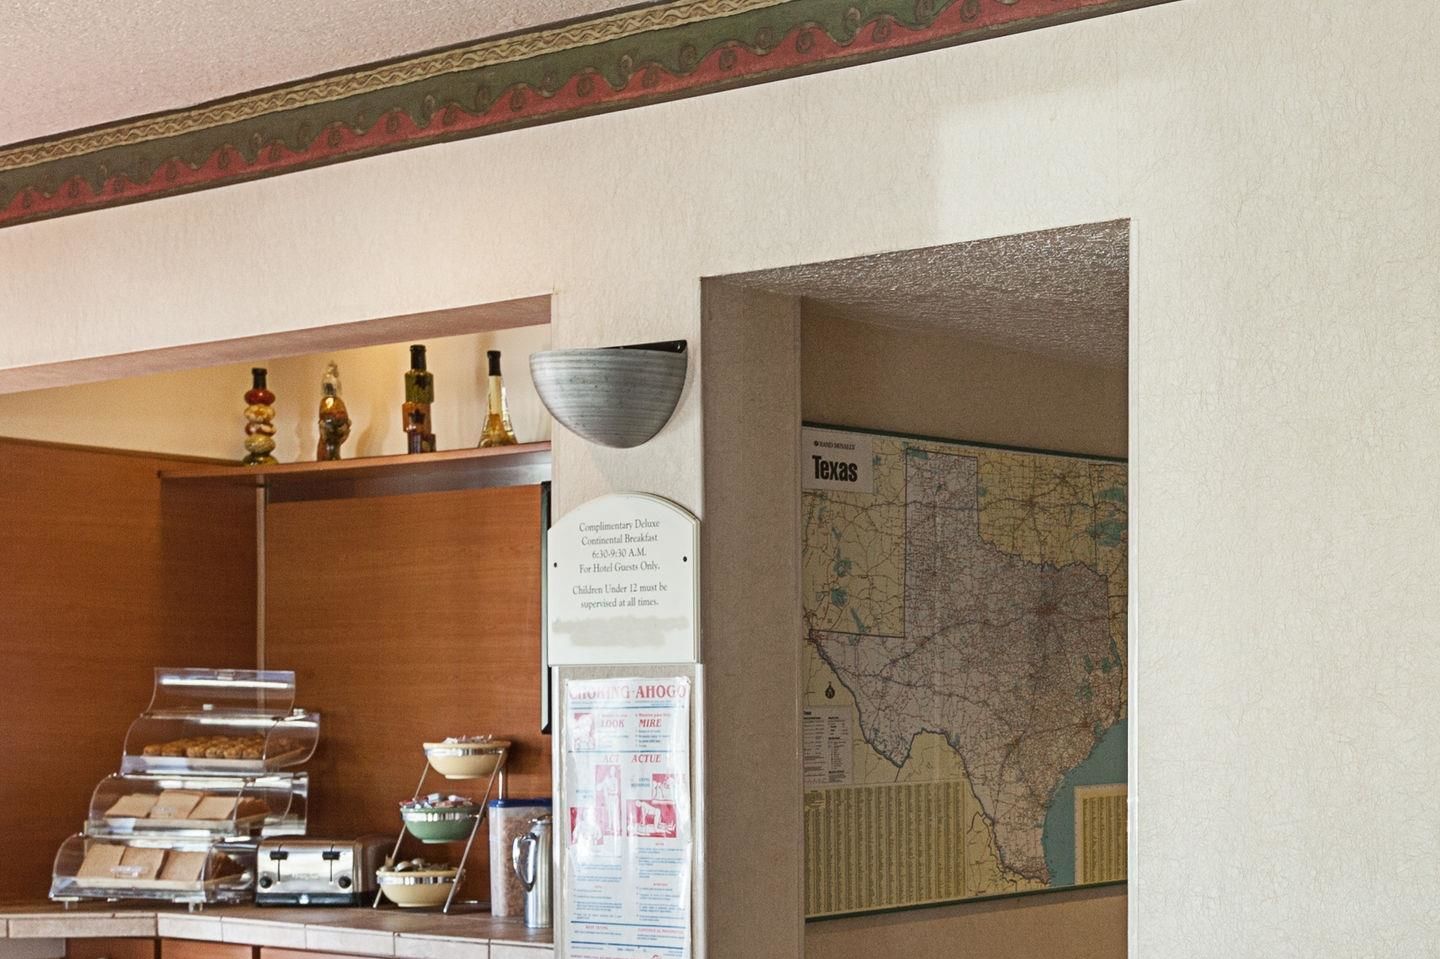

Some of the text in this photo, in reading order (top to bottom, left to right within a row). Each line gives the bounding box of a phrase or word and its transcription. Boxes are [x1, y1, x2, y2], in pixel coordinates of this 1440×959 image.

[812, 455, 858, 482] Texas
[579, 519, 660, 533] Complimentary Deluxe
[581, 533, 658, 546] Continental Breakfast
[592, 548, 647, 559] 6:30-9:30 A.M.
[579, 561, 660, 574] For Hotel Guests Only.
[573, 582, 668, 595] Children Under 12 must be
[581, 597, 659, 610] supervised at all times.
[639, 718, 662, 728] MIRE
[631, 754, 661, 763] ACTUE
